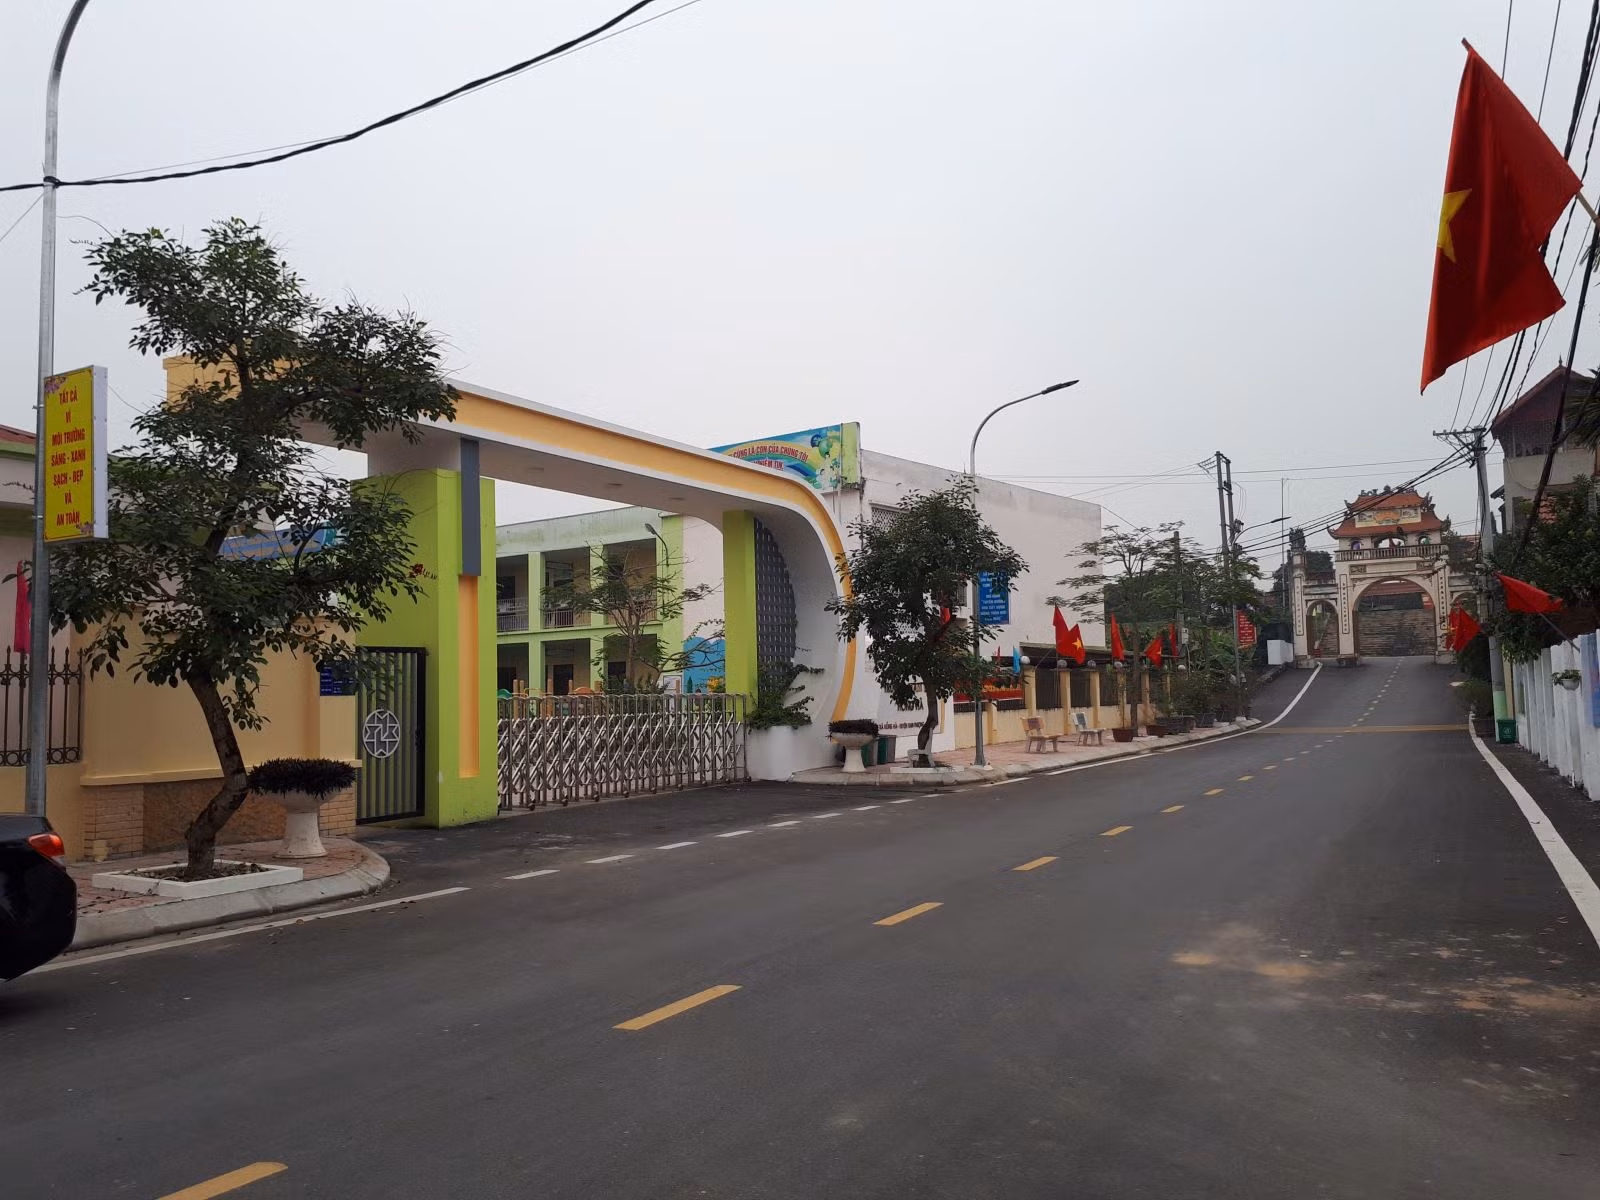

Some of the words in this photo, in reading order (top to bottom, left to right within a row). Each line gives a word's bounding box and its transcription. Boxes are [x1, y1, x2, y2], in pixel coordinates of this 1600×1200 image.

[59, 389, 69, 405] TẤT
[69, 386, 78, 402] CẢ
[65, 409, 72, 424] VÌ
[52, 432, 63, 447] MÔI
[63, 428, 86, 444] TRƯỜNG
[51, 450, 66, 467] SÁNG
[71, 448, 86, 464] XANH
[53, 471, 68, 489] SẠCH
[72, 469, 84, 487] ĐẸP
[64, 491, 72, 505] VÀ
[56, 513, 65, 527] AN
[65, 509, 81, 526] TOÀN
